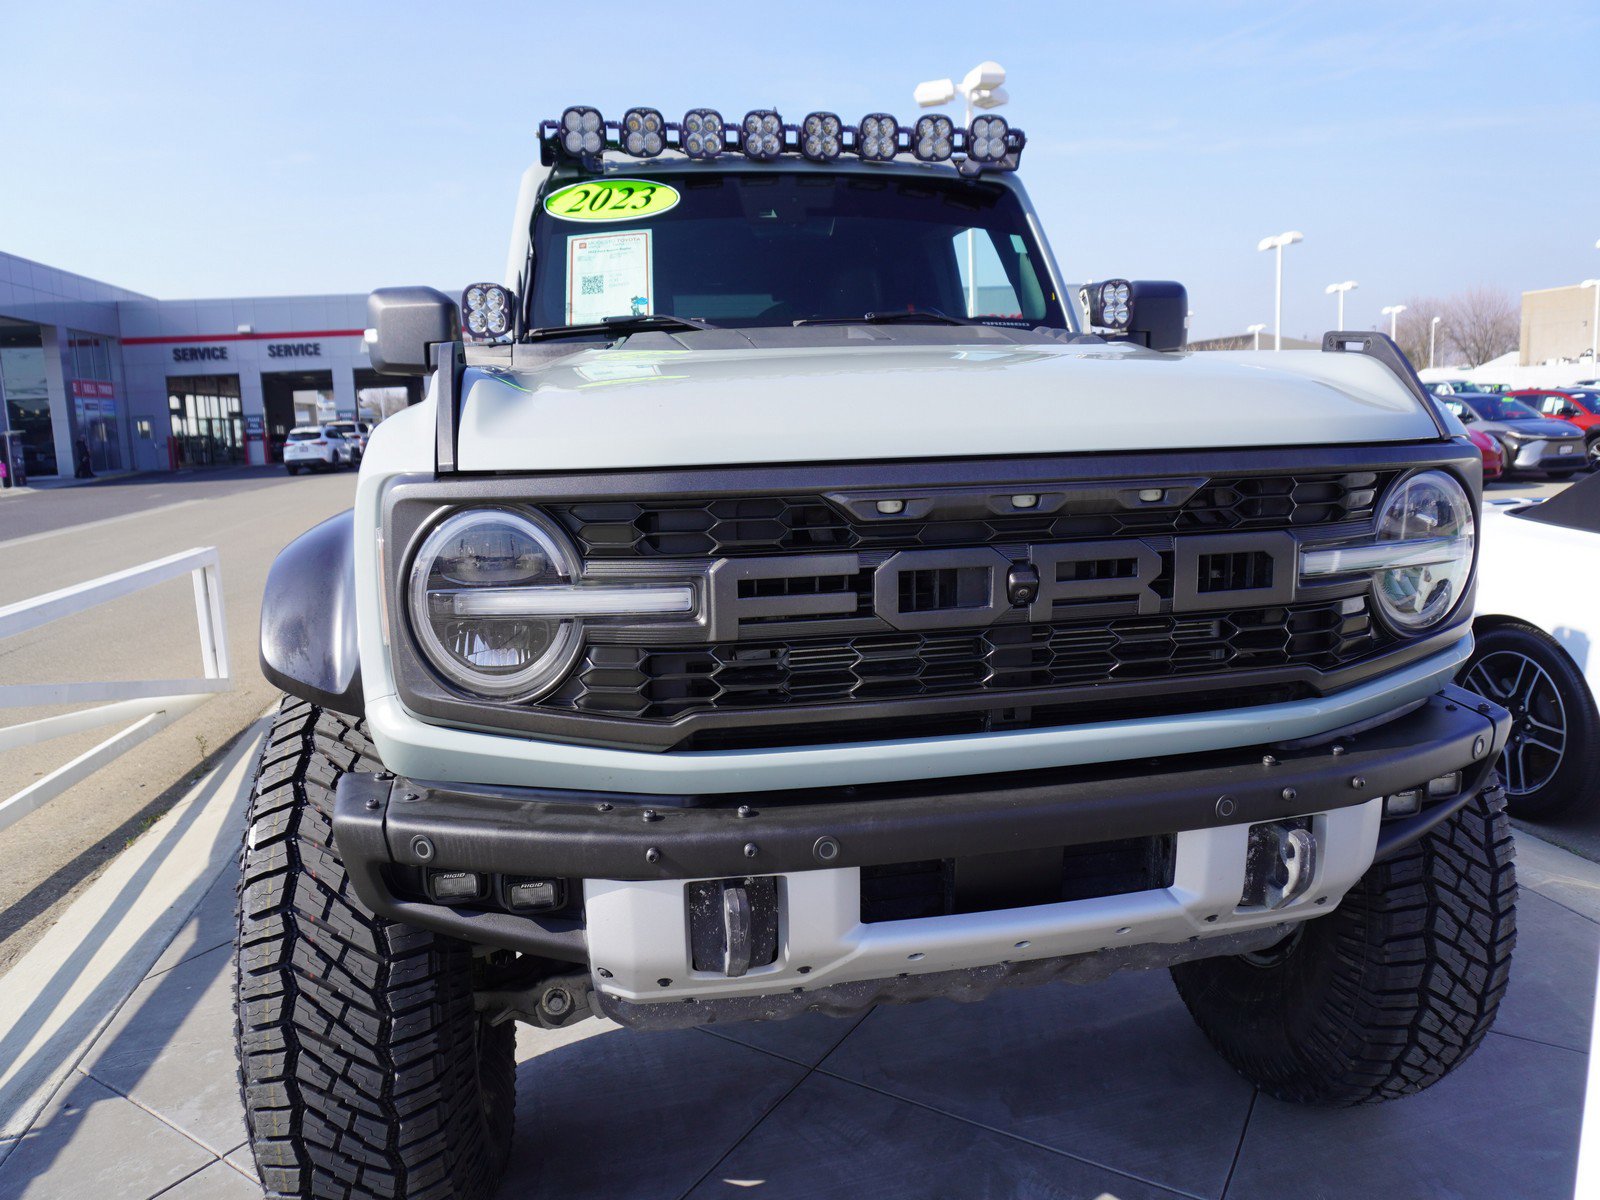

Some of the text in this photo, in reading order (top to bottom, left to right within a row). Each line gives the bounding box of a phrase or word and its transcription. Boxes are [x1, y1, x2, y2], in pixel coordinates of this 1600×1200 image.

[565, 186, 656, 213] 2023
[172, 346, 228, 362] SERVICE
[267, 343, 321, 358] SERVICE
[707, 529, 1298, 642] FORD
